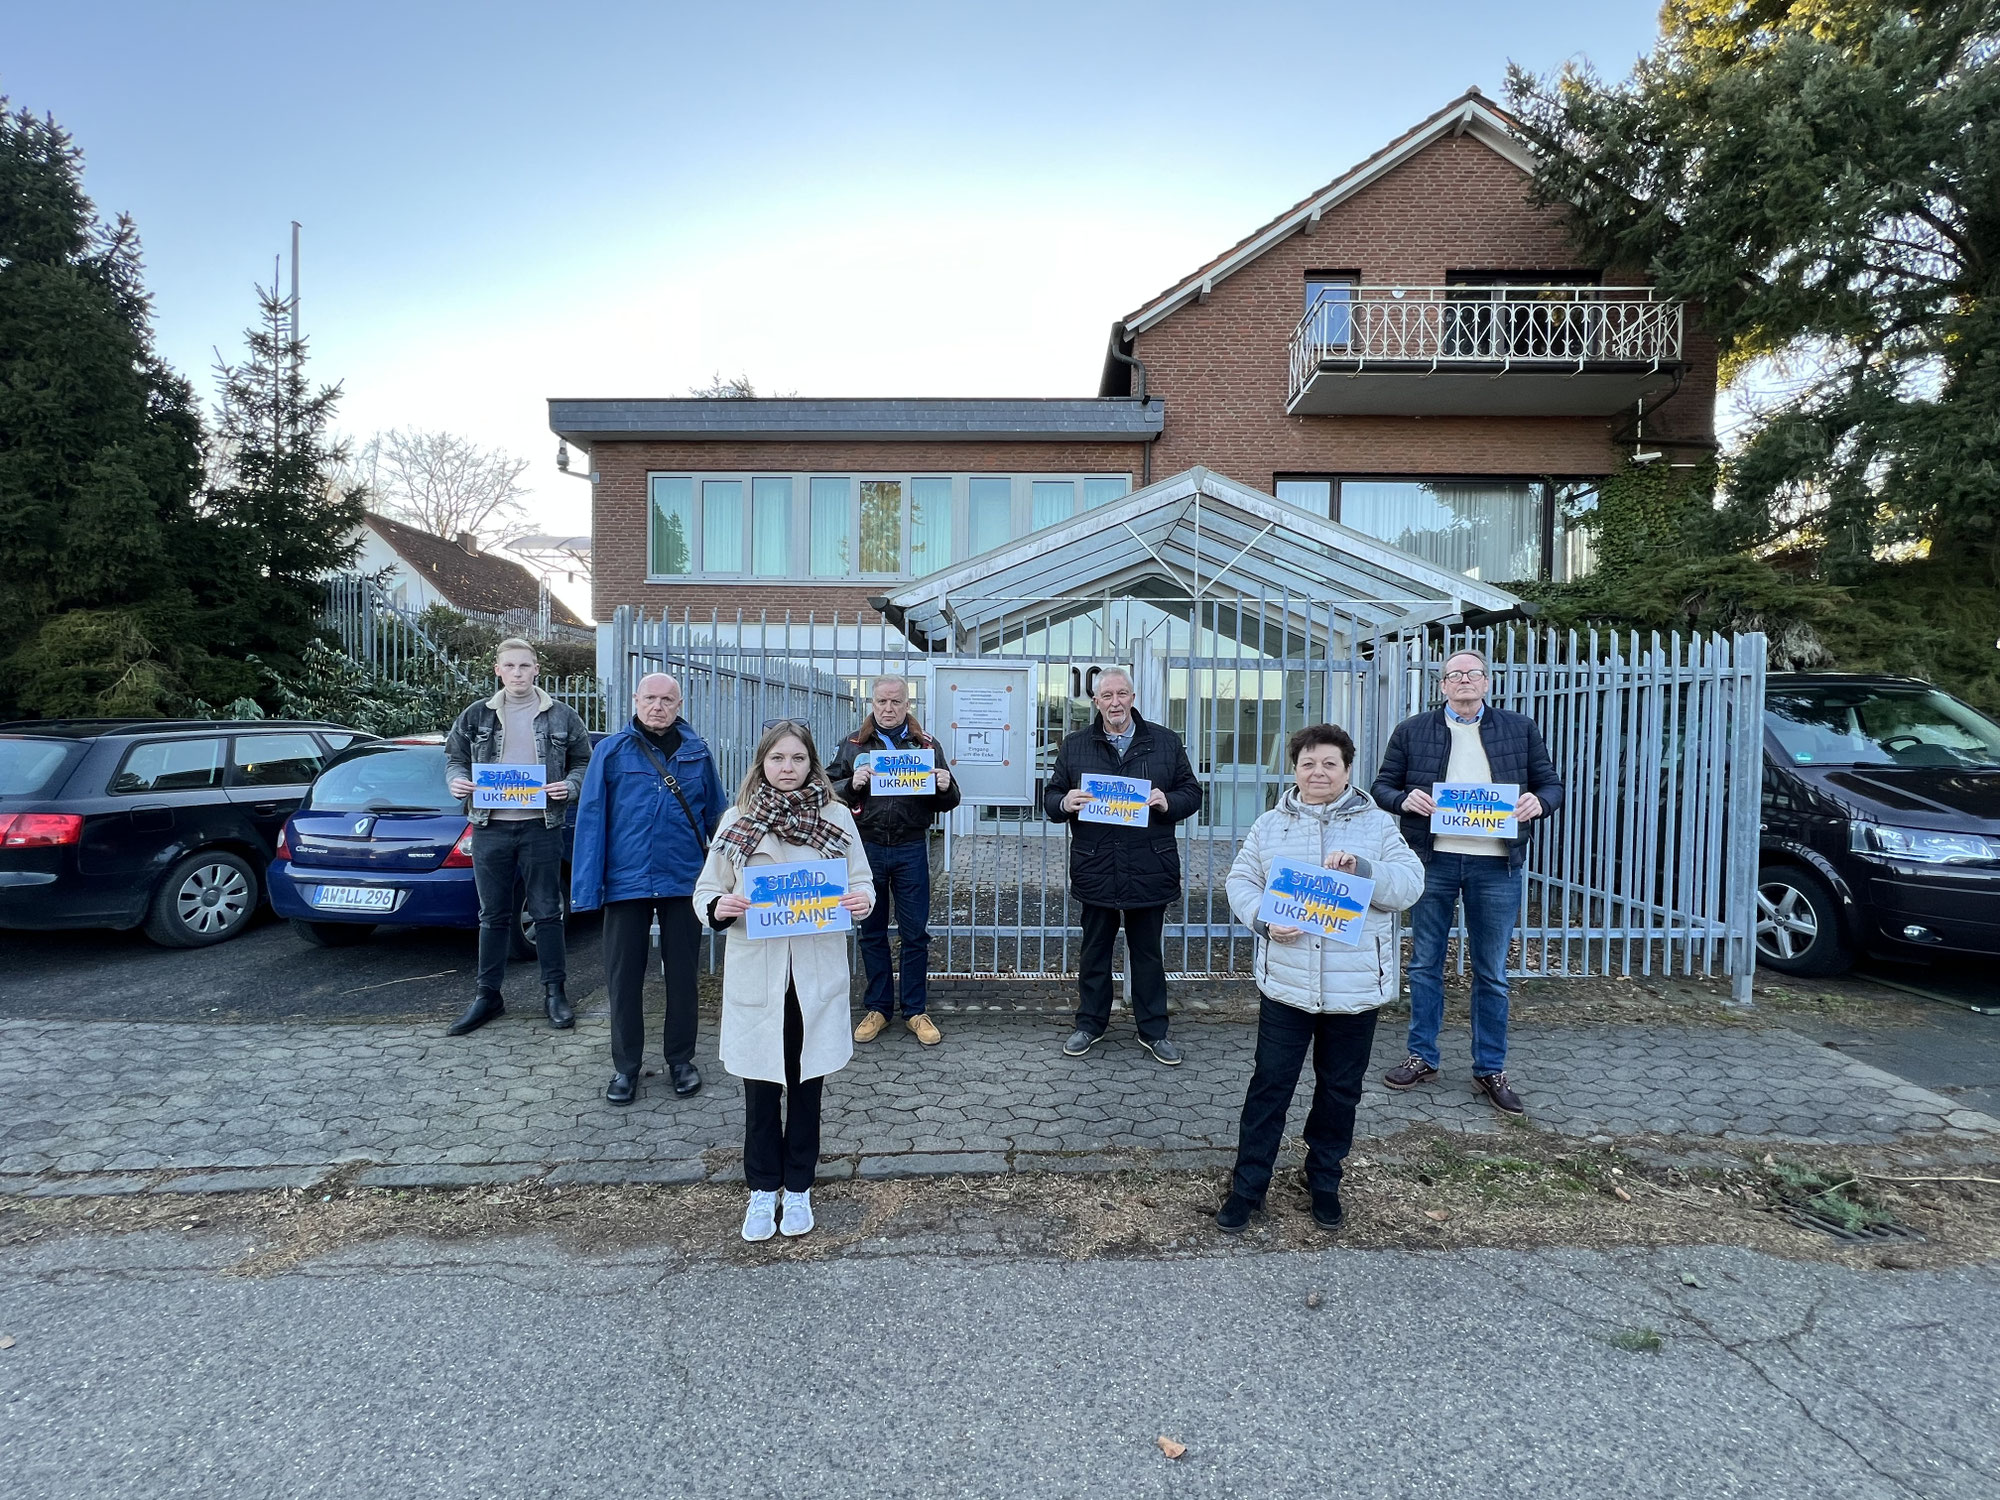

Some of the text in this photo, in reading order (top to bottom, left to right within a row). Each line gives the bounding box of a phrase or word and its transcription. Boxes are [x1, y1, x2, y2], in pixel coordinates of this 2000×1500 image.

[884, 756, 921, 765] STAND
[488, 771, 530, 780] STAND
[888, 767, 917, 776] WITH
[493, 782, 525, 791] WITH
[879, 779, 927, 788] UKRAINE
[1095, 781, 1136, 793] STAND
[482, 793, 537, 802] UKRAINE
[1100, 793, 1130, 805] WITH
[1450, 789, 1500, 802] STAND
[1088, 804, 1140, 819] UKRAINE
[1455, 803, 1493, 815] WITH
[1442, 815, 1505, 829] UKRAINE
[766, 871, 826, 890] STAND
[1289, 870, 1349, 896] STAND
[320, 887, 392, 906] AW LL 296
[774, 889, 821, 908] WITH
[1293, 889, 1339, 912] WITH
[760, 907, 837, 927] UKRAINE
[1273, 901, 1350, 932] UKRAINE
